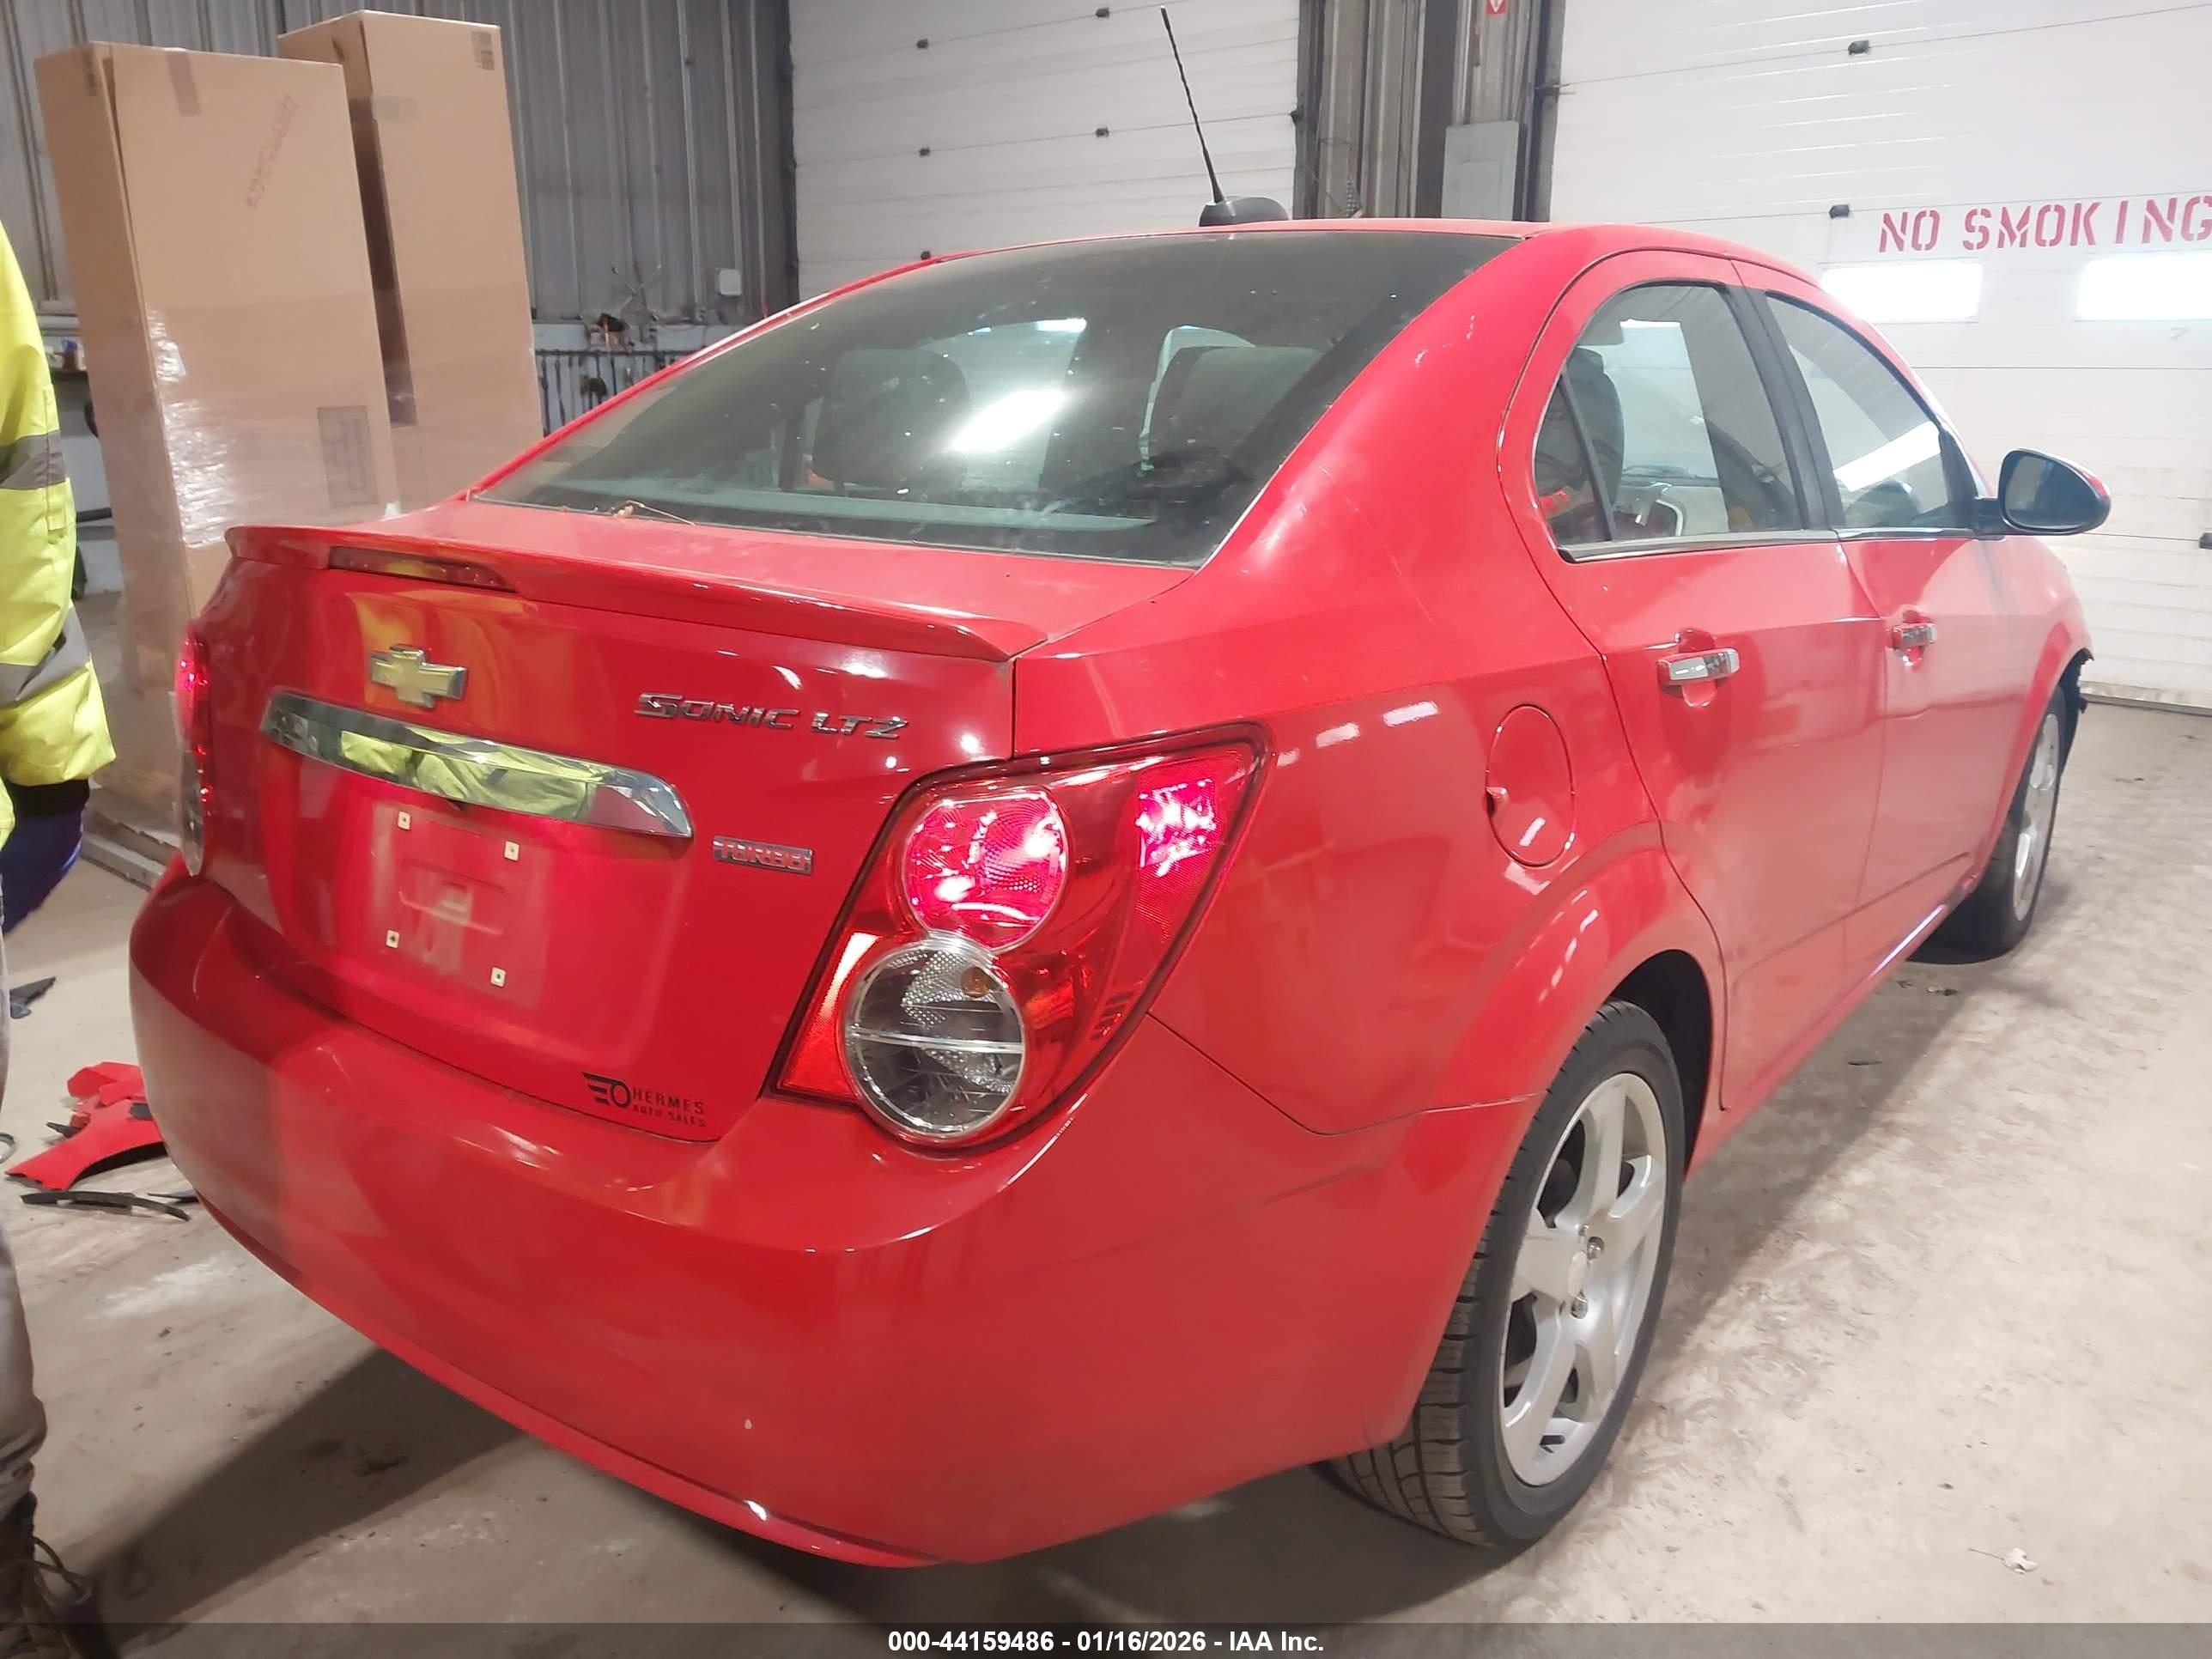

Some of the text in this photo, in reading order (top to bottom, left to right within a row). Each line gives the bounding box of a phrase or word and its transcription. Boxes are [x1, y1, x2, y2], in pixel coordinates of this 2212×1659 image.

[1879, 196, 2212, 252] NO SMOKING
[634, 692, 908, 739] SONIC LTZ
[720, 842, 805, 871] TURBO
[633, 1087, 705, 1115] HERMES
[633, 1104, 706, 1127] AUTO SALES
